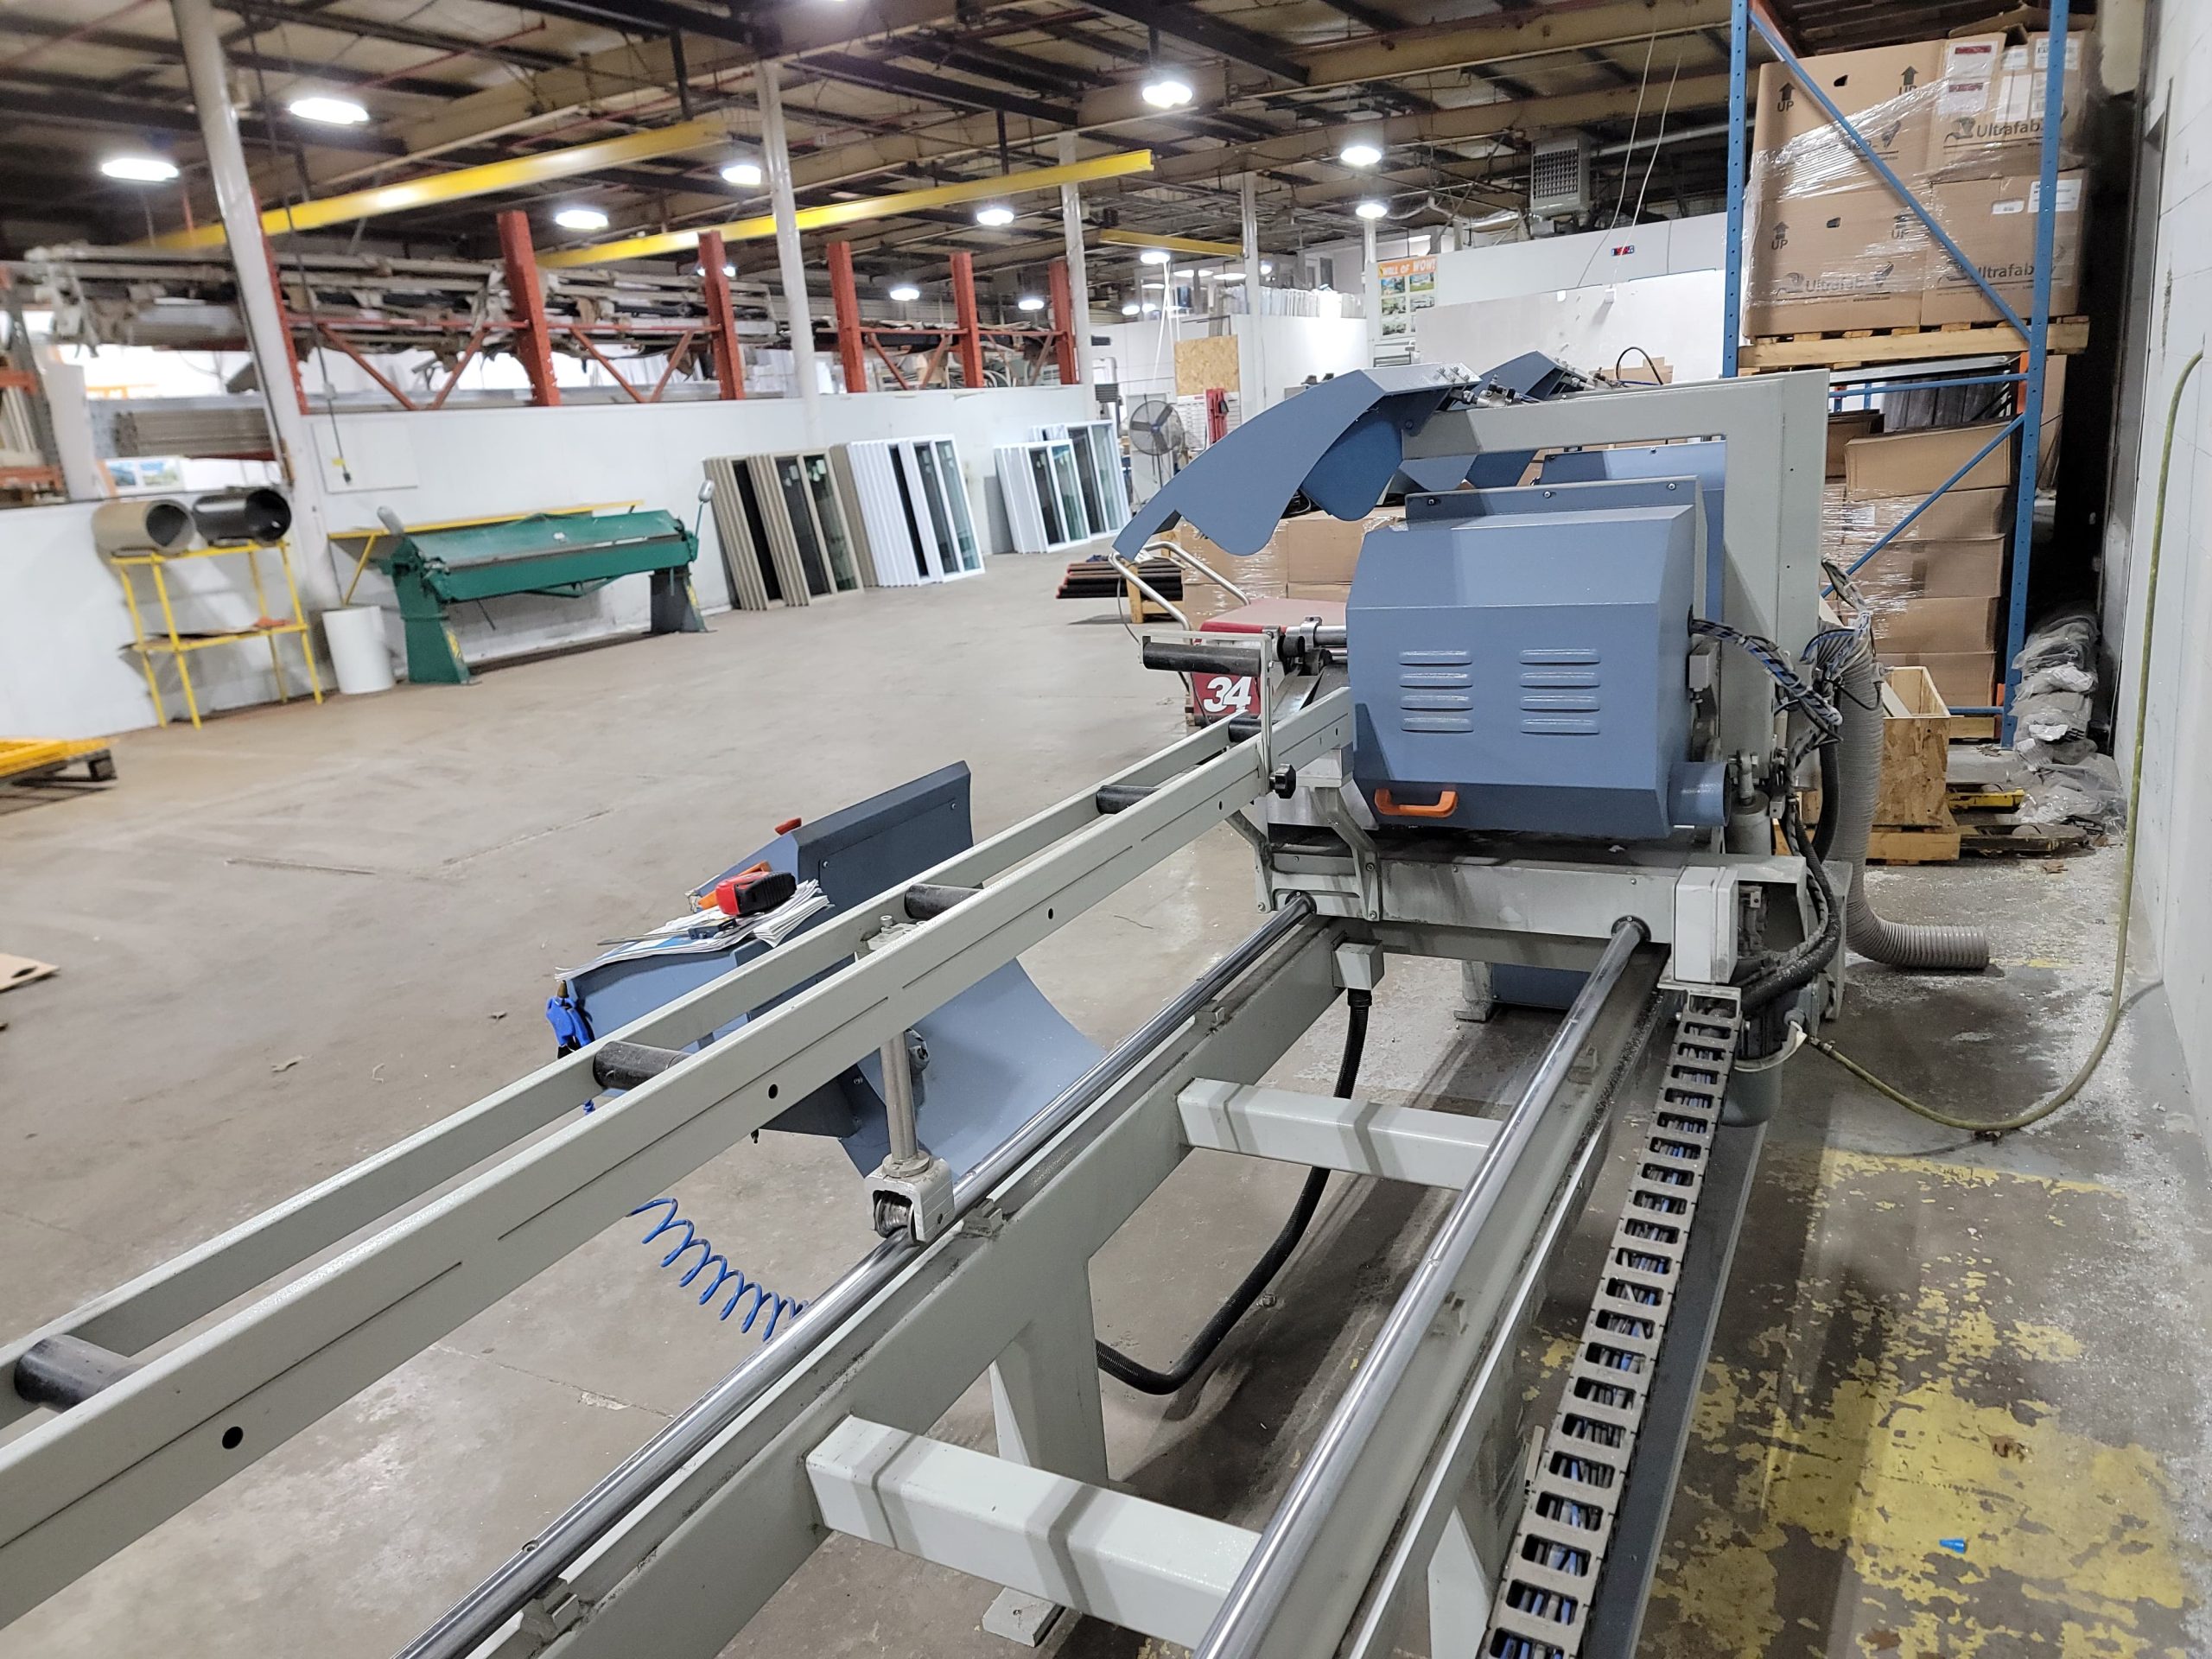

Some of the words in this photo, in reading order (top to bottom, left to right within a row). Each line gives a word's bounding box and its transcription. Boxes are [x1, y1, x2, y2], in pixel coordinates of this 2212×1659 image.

[1777, 100, 1795, 112] UP
[1976, 121, 2041, 138] Ultrafab
[1771, 239, 1789, 251] UP
[1400, 264, 1410, 274] OF
[1413, 258, 1437, 272] WOW!
[1204, 676, 1252, 713] 34
